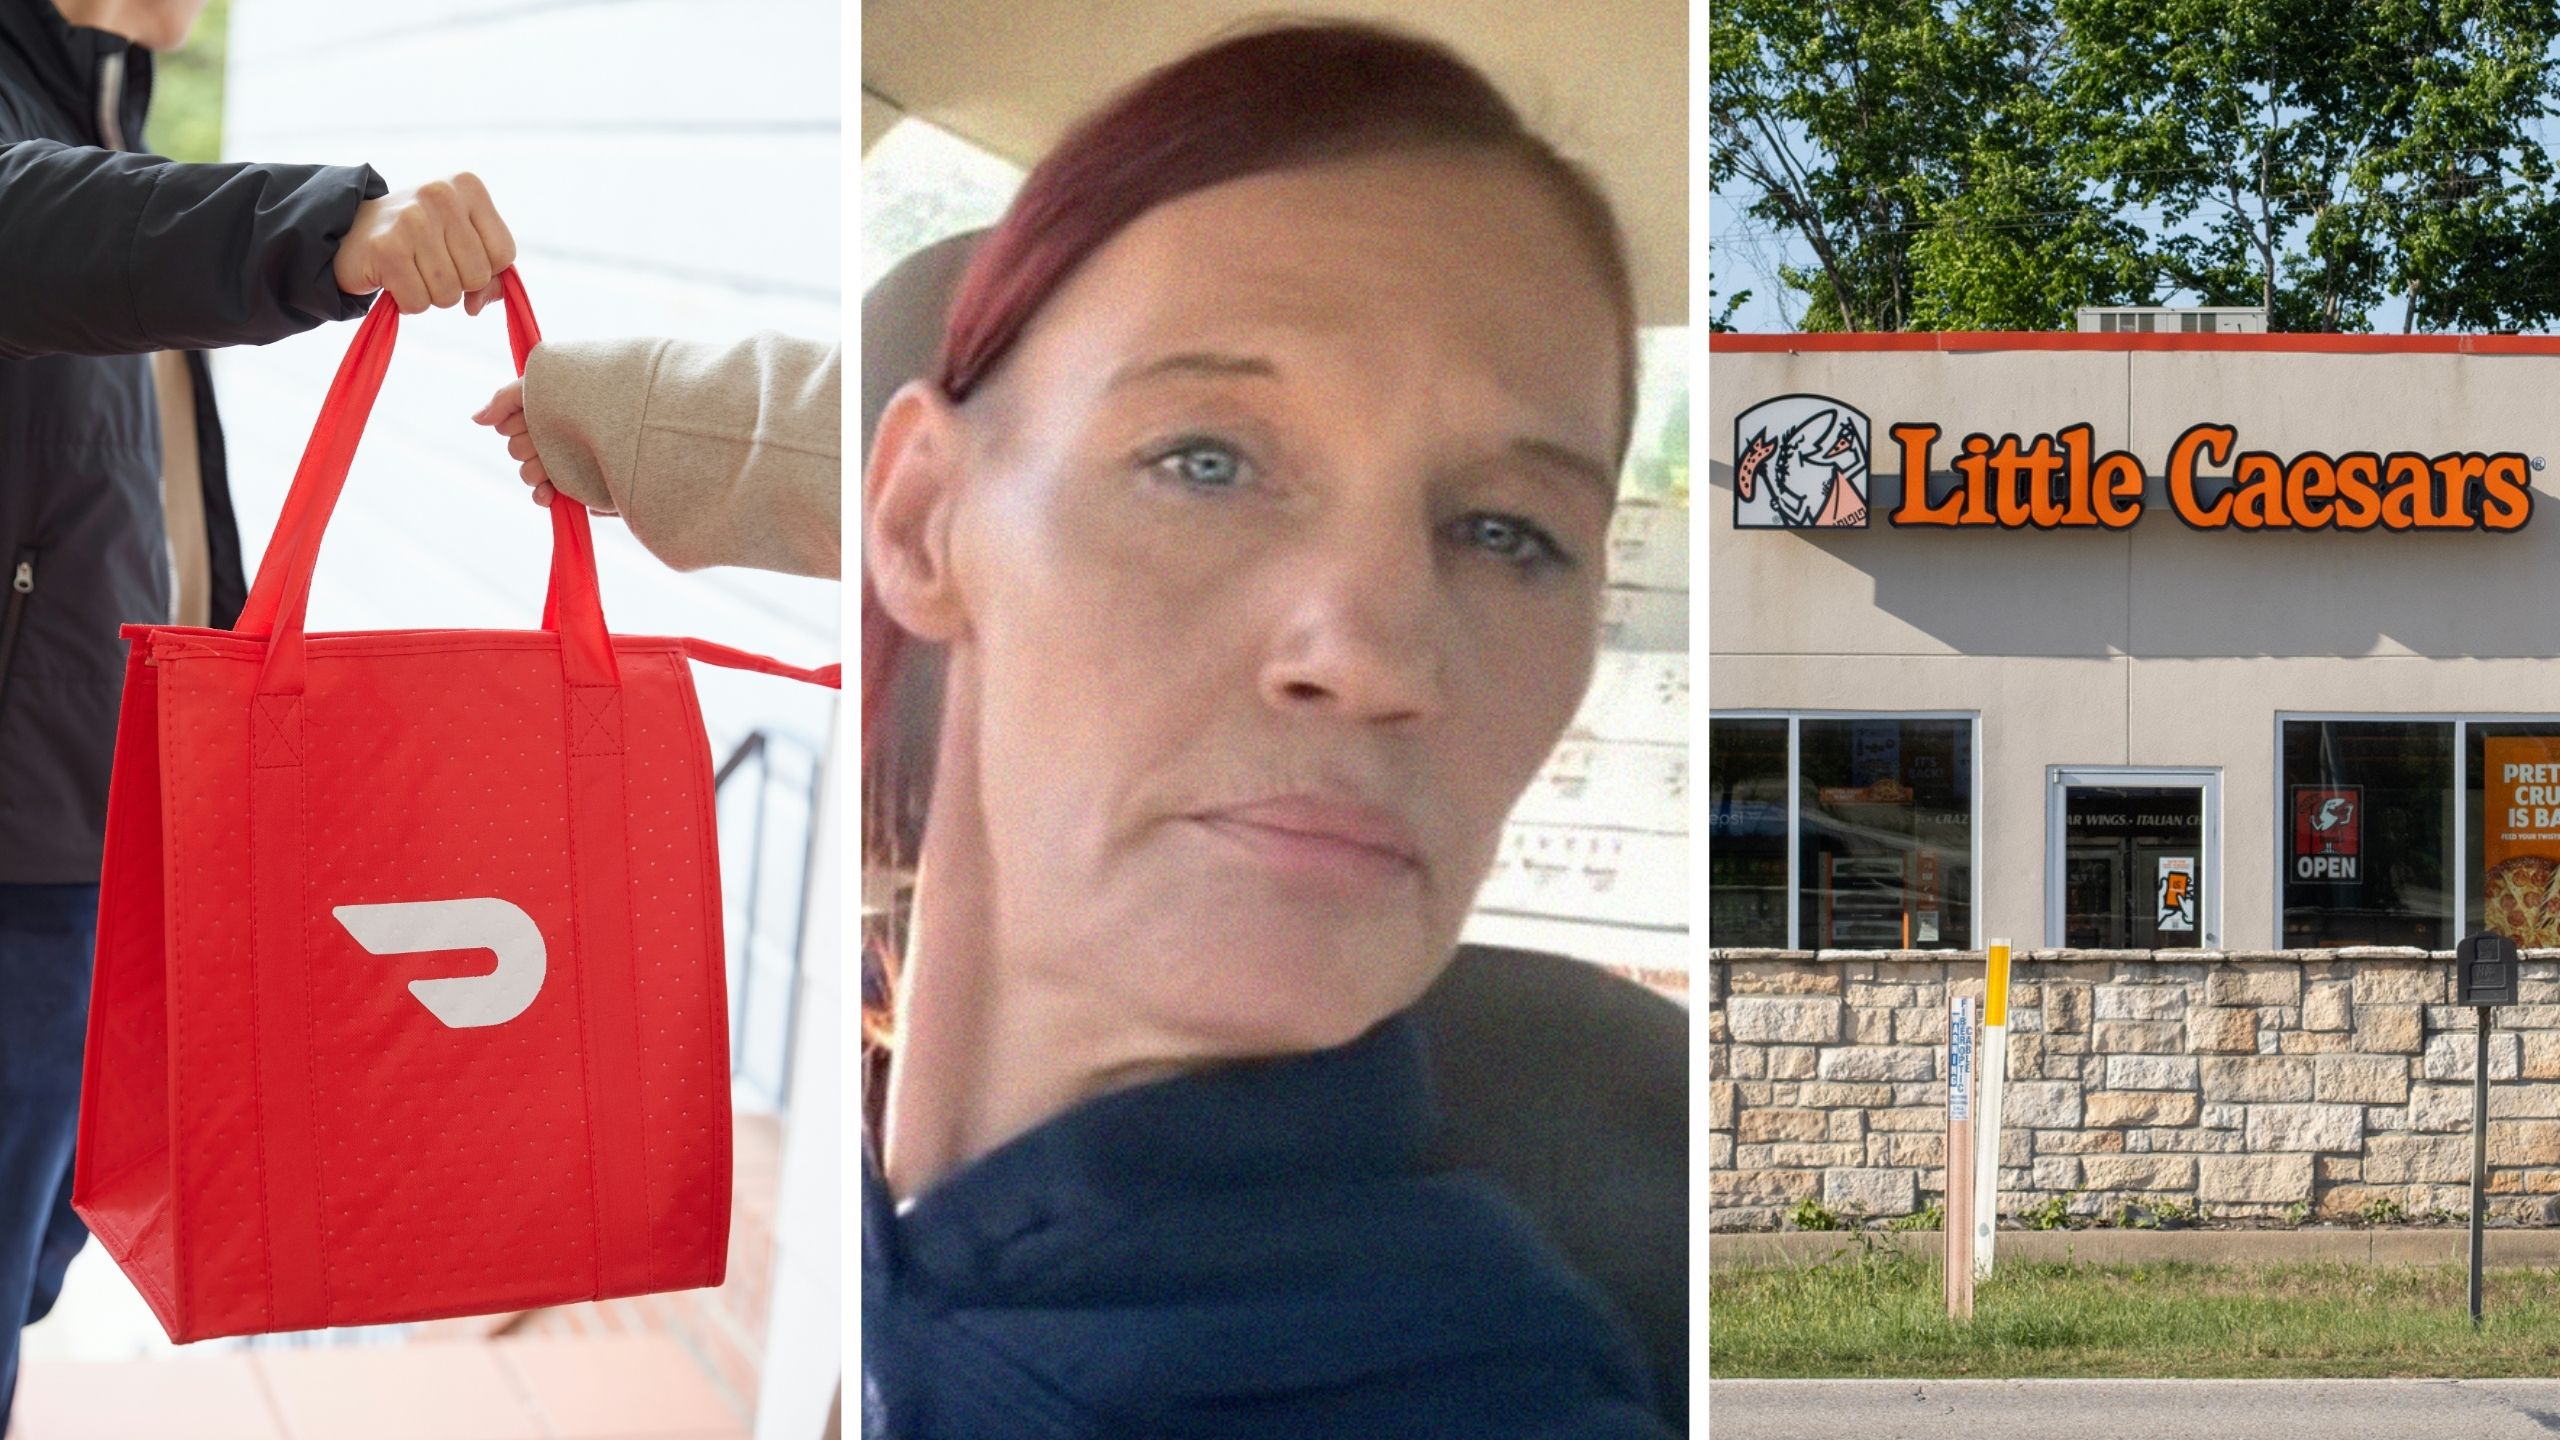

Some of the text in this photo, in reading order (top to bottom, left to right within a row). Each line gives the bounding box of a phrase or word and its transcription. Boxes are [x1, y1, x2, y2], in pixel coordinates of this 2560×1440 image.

[1889, 422, 2533, 532] Little Caesars
[2504, 764, 2560, 783] PRET
[2515, 786, 2560, 806] CRU
[2136, 814, 2182, 826] ITALIAN
[2508, 808, 2529, 828] IS
[2297, 856, 2357, 879] OPEN
